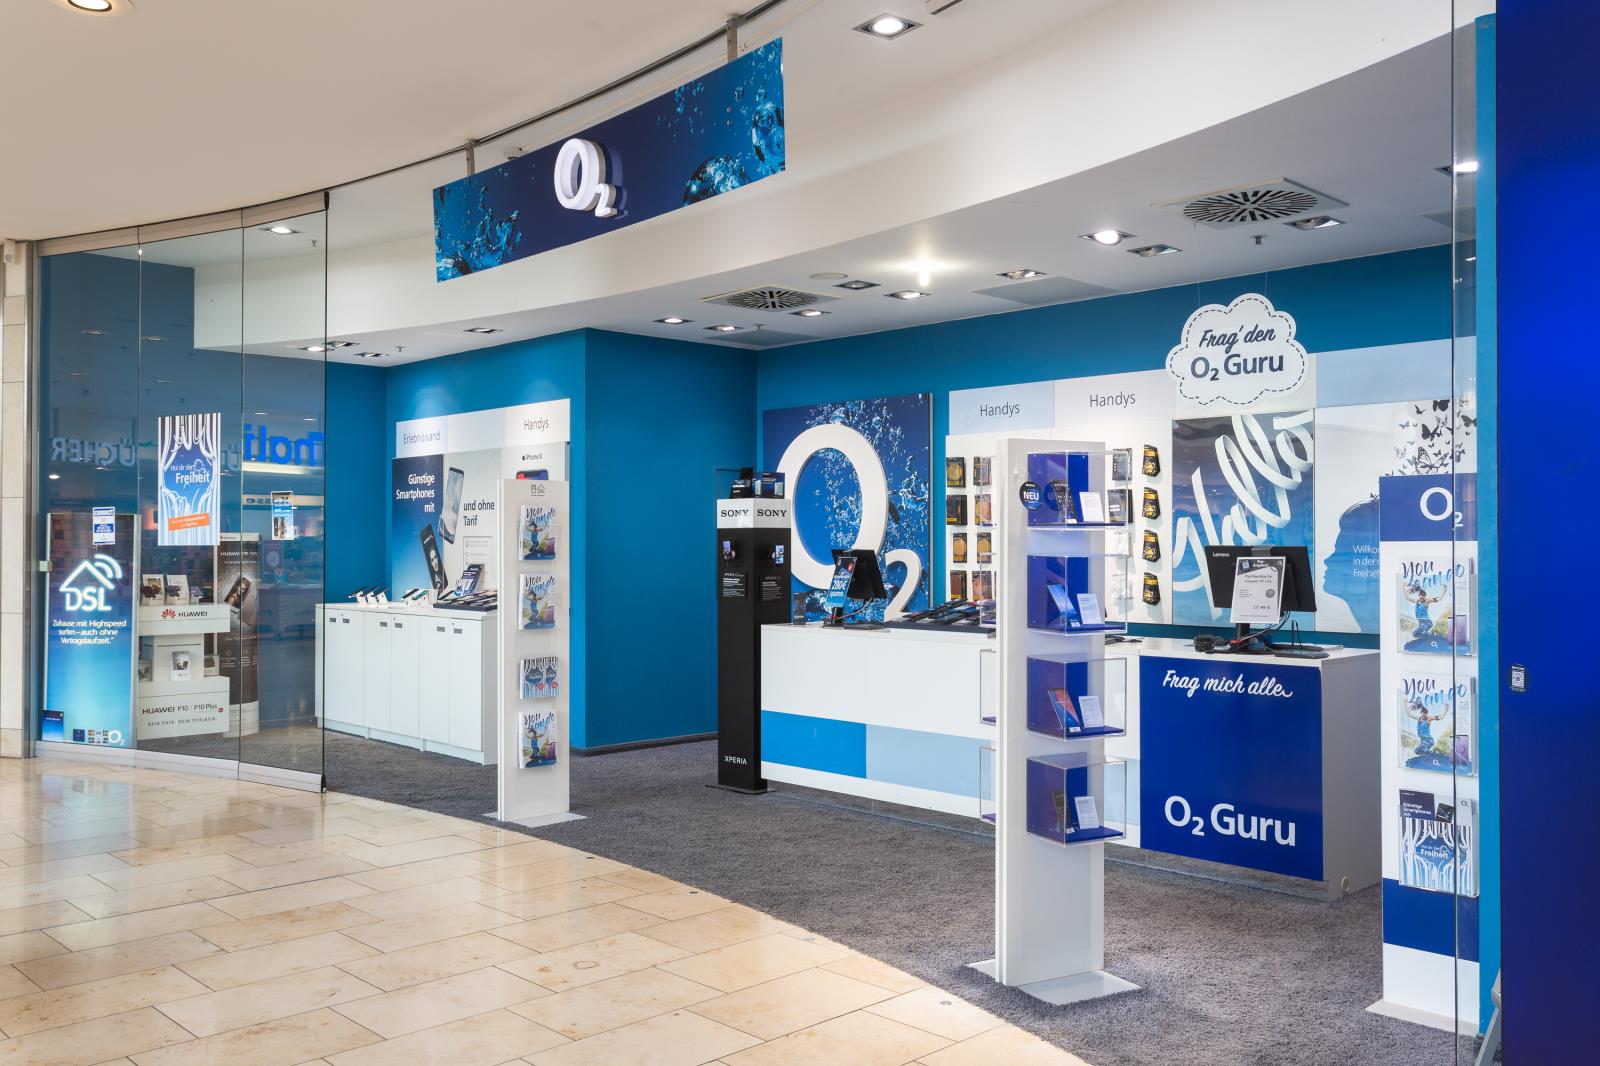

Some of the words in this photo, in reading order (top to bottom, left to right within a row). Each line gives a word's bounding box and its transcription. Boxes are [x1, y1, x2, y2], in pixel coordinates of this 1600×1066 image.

[554, 138, 617, 217] O2
[1244, 324, 1276, 343] den
[1191, 356, 1220, 381] O2
[1224, 353, 1284, 376] Guru
[1089, 391, 1136, 409] Handys
[980, 402, 1020, 418] Handys
[524, 419, 549, 433] Handys
[403, 431, 441, 445] Erlebniswand
[176, 472, 210, 484] Freiheit
[408, 474, 435, 486] Günstige
[396, 489, 435, 501] Smartphones
[1023, 490, 1040, 500] NEU
[424, 502, 435, 513] mit
[464, 500, 476, 511] und
[478, 500, 495, 511] ohne
[1420, 486, 1464, 527] O2
[721, 509, 749, 518] SONY
[757, 508, 787, 518] SONY
[464, 515, 478, 527] Tarif
[1362, 556, 1375, 566] der
[1402, 561, 1433, 587] You
[65, 587, 112, 612] DSL
[178, 610, 208, 618] HUAWEI
[89, 620, 127, 629] Highspeed
[99, 628, 118, 636] ohne
[1162, 670, 1201, 698] Frag
[1203, 673, 1245, 694] mich
[1403, 678, 1435, 701] You
[142, 706, 175, 715] HUAWEI
[724, 755, 747, 765] XPERIA
[1164, 795, 1205, 837] O2
[1210, 803, 1296, 847] Guru
[1420, 848, 1449, 859] Freiheit
